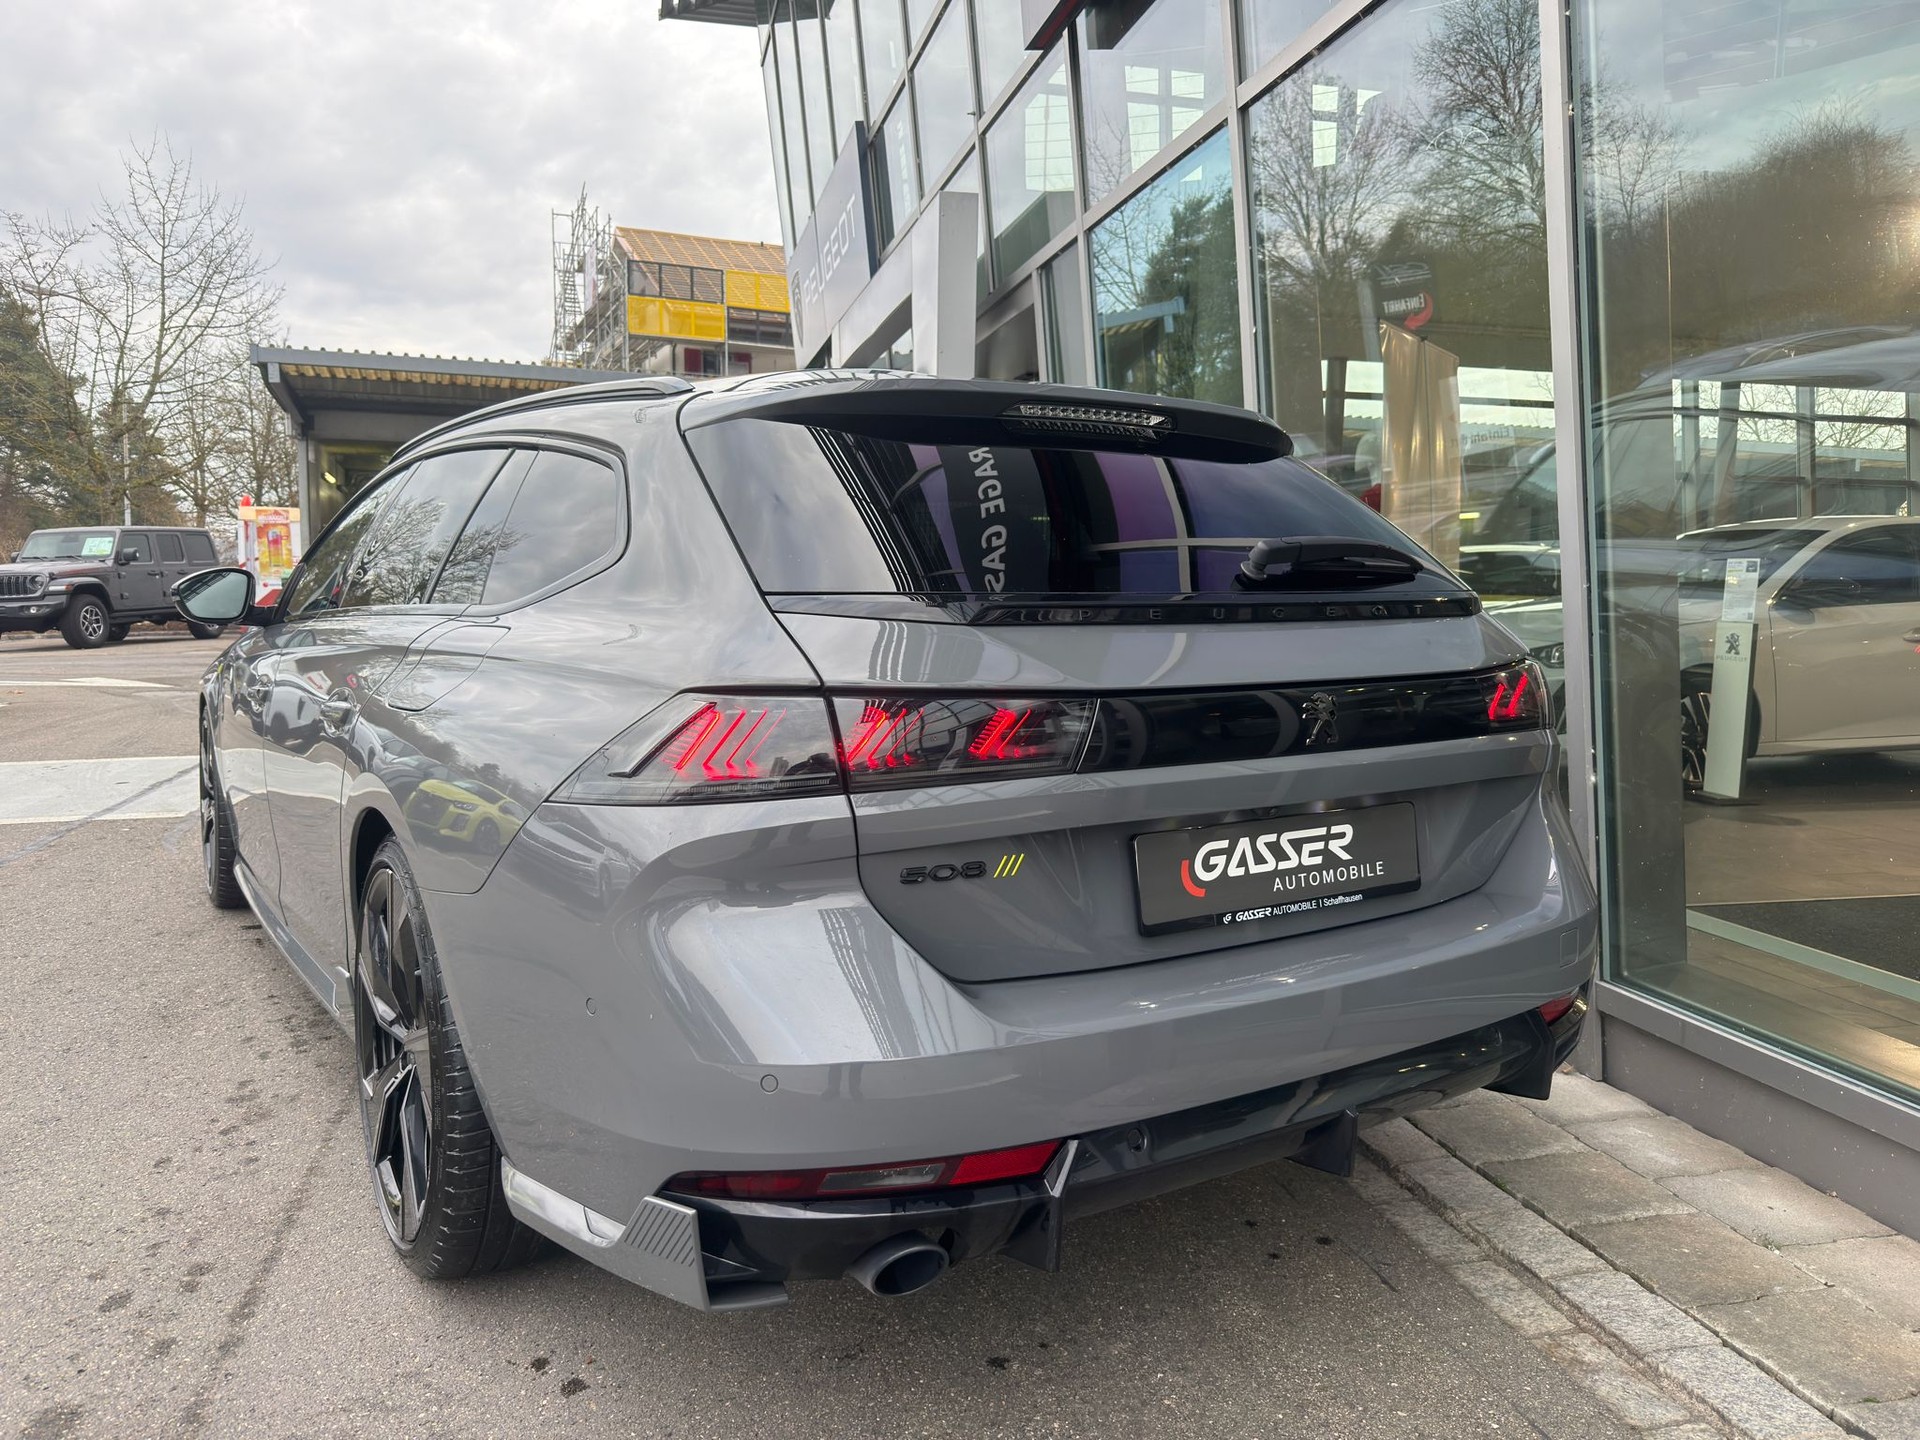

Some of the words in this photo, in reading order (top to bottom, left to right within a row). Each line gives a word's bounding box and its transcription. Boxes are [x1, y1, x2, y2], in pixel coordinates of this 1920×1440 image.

[803, 193, 857, 305] PEUGEOT
[1193, 823, 1354, 882] GASSER
[899, 860, 987, 884] 508
[1273, 861, 1385, 892] AUTOMOBILE
[1235, 907, 1273, 922] GASSER
[1272, 900, 1318, 916] AUTOMOBILE
[1323, 893, 1363, 907] Schaffhausen
